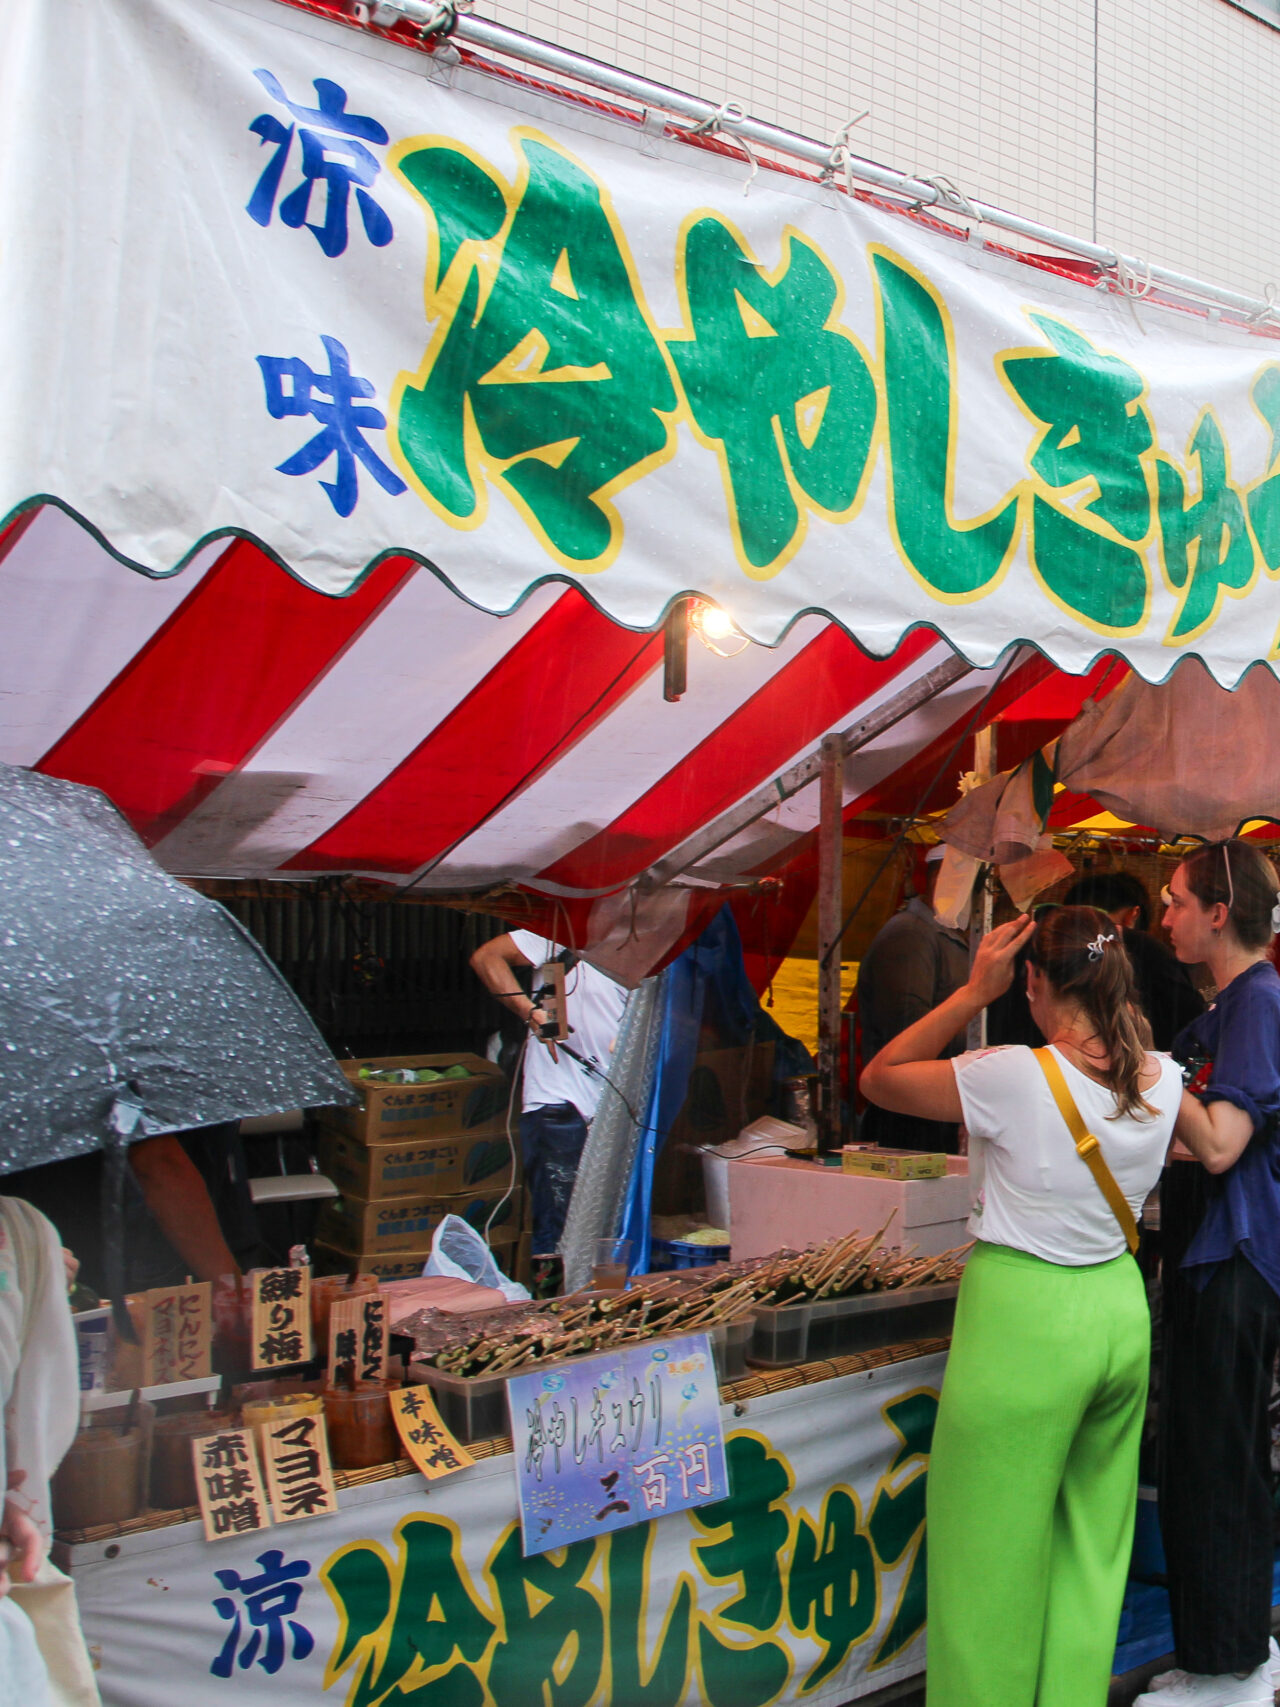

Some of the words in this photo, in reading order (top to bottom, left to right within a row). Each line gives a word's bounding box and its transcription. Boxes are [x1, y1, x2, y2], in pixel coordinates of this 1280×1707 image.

[245, 69, 408, 518] 涼味
[178, 1294, 204, 1380] にんにく
[259, 1269, 303, 1365] 練り梅
[360, 1300, 385, 1383] にんにく
[271, 1417, 329, 1516] マヨネ
[400, 1390, 463, 1471] 辛味噌
[202, 1434, 262, 1535] 赤味噌
[210, 1550, 315, 1678] 涼
